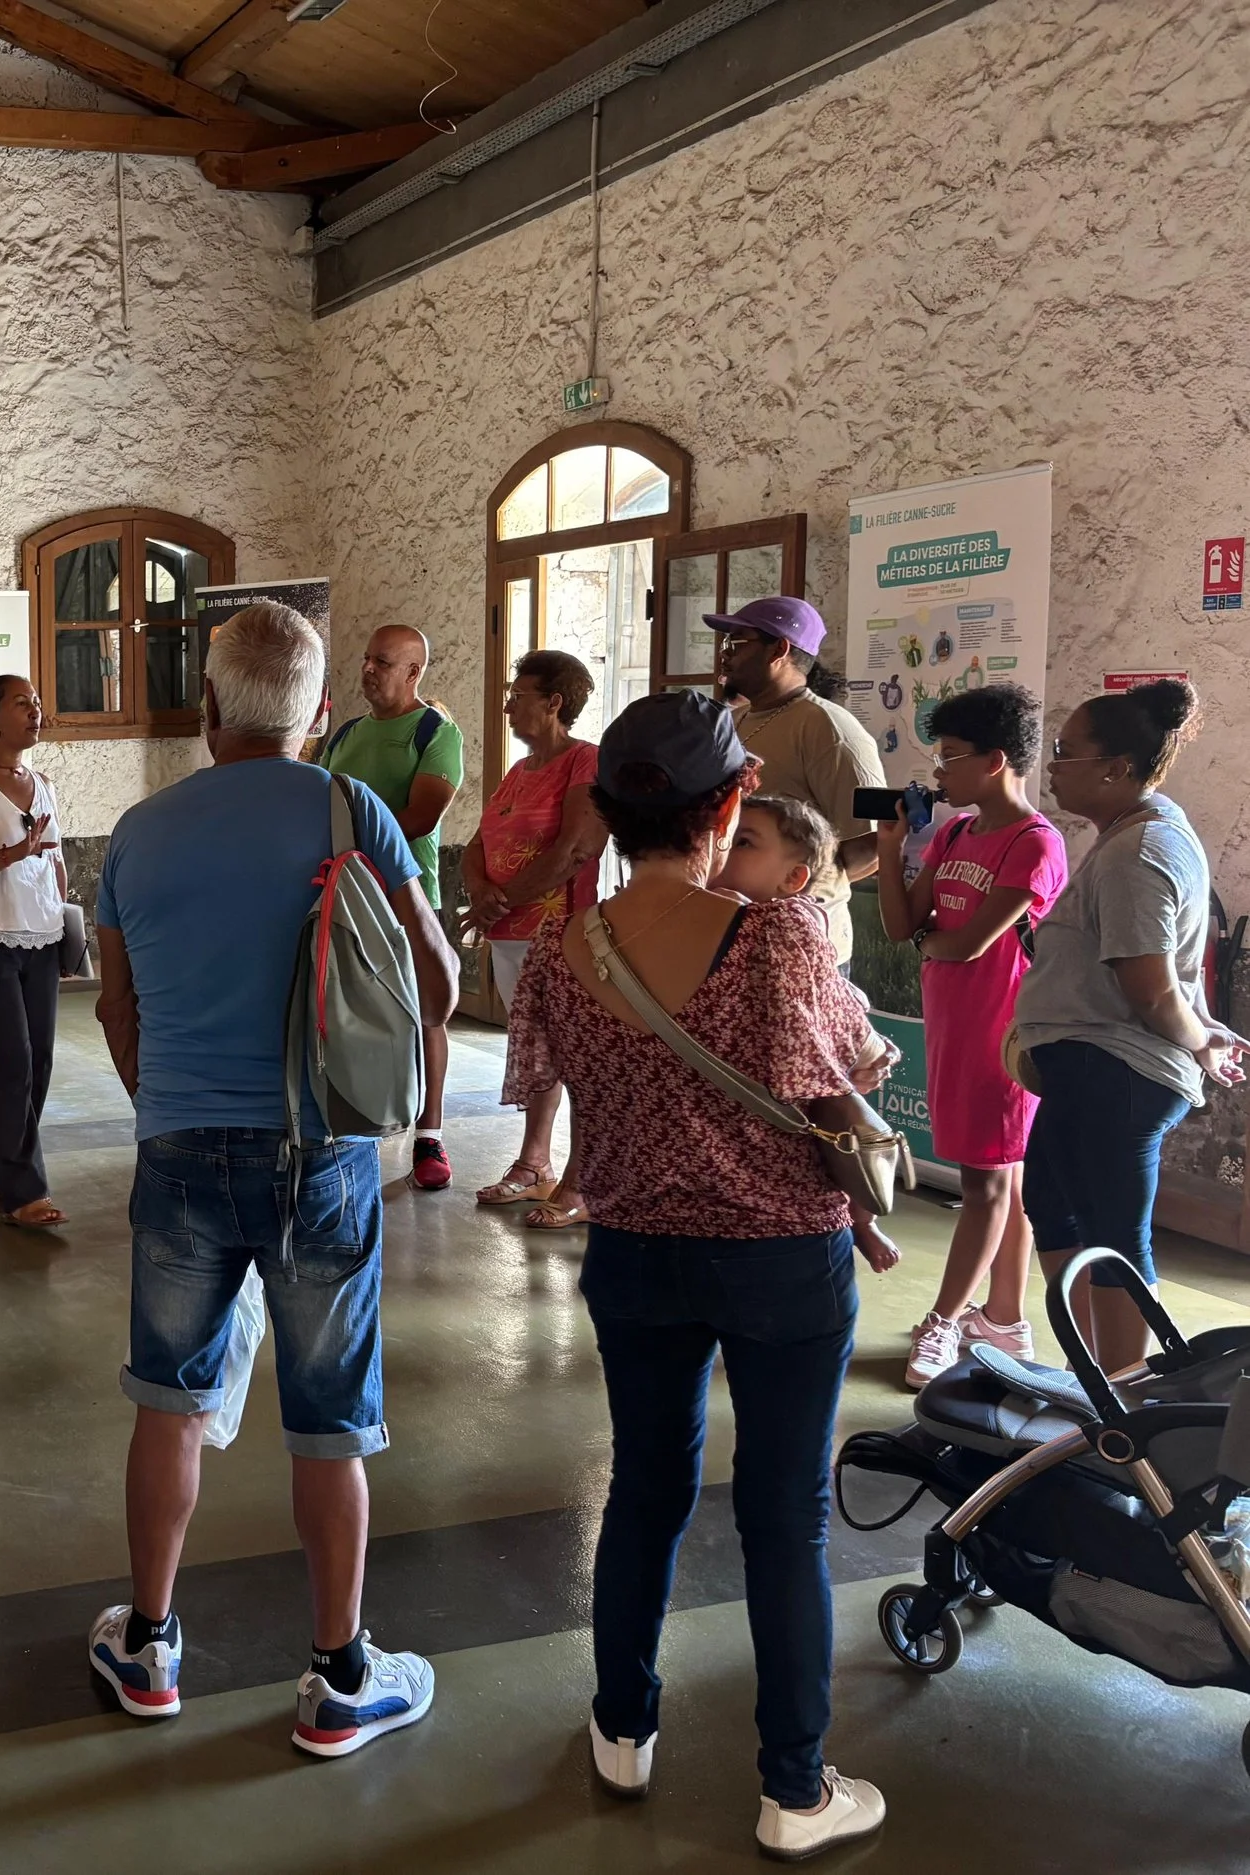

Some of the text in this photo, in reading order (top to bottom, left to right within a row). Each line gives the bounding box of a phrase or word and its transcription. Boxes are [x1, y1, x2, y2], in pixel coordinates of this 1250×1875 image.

[866, 502, 956, 528] LA FILIÈRE CANNE-SUCRE
[894, 538, 991, 562] LA DIVERSITÉ DES
[880, 554, 1004, 581] MÉTIERS DE LA FILIÈRE
[215, 598, 233, 607] FILIÈRE
[934, 860, 994, 894] ALIFORNIA
[940, 893, 966, 911] VITALITY
[897, 1117, 906, 1126] LA
[908, 1119, 932, 1133] RÉUNI
